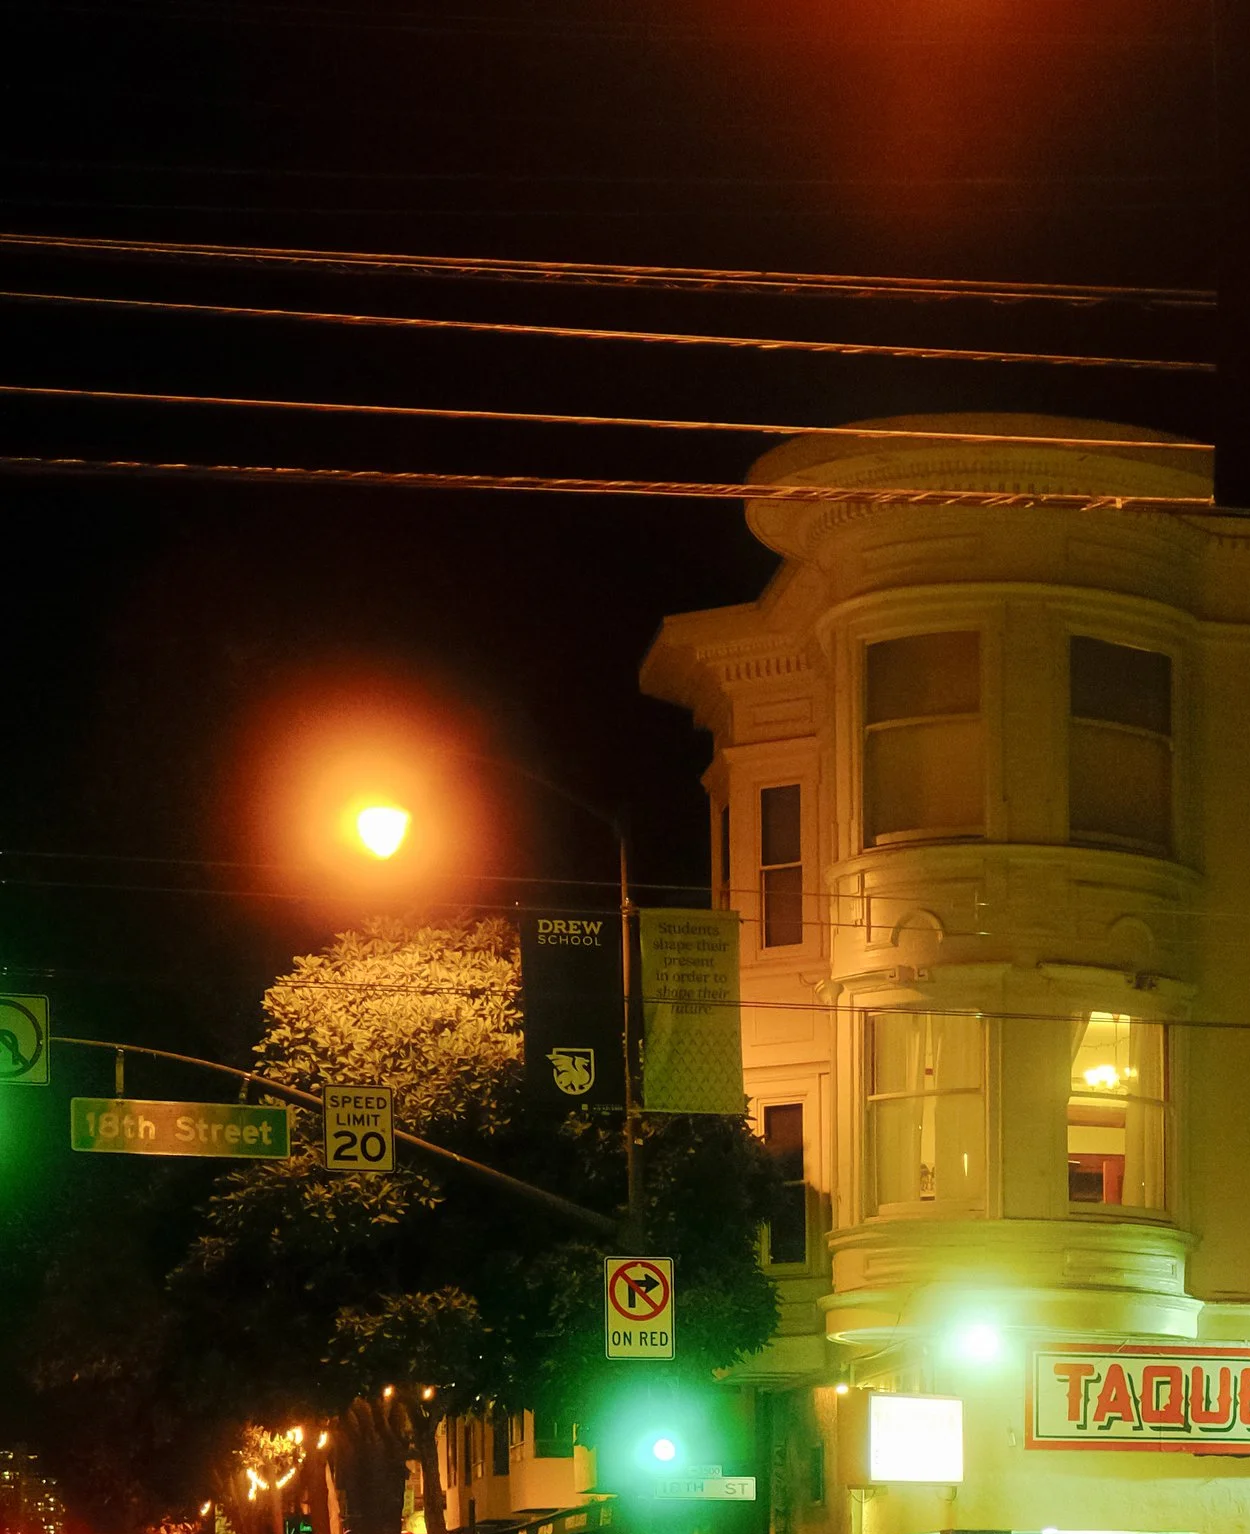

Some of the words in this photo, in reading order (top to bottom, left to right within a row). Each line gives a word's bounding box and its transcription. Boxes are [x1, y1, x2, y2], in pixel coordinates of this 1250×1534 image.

[538, 919, 603, 935] DREW
[659, 922, 719, 936] Students
[537, 935, 601, 946] SCHOOL
[330, 1095, 387, 1109] SPEED
[336, 1113, 381, 1126] LIMIT
[86, 1111, 156, 1140] 18th
[174, 1115, 272, 1145] Street
[333, 1130, 387, 1162] 20
[612, 1331, 632, 1346] ON
[639, 1331, 669, 1346] RED
[725, 1483, 748, 1495] ST
